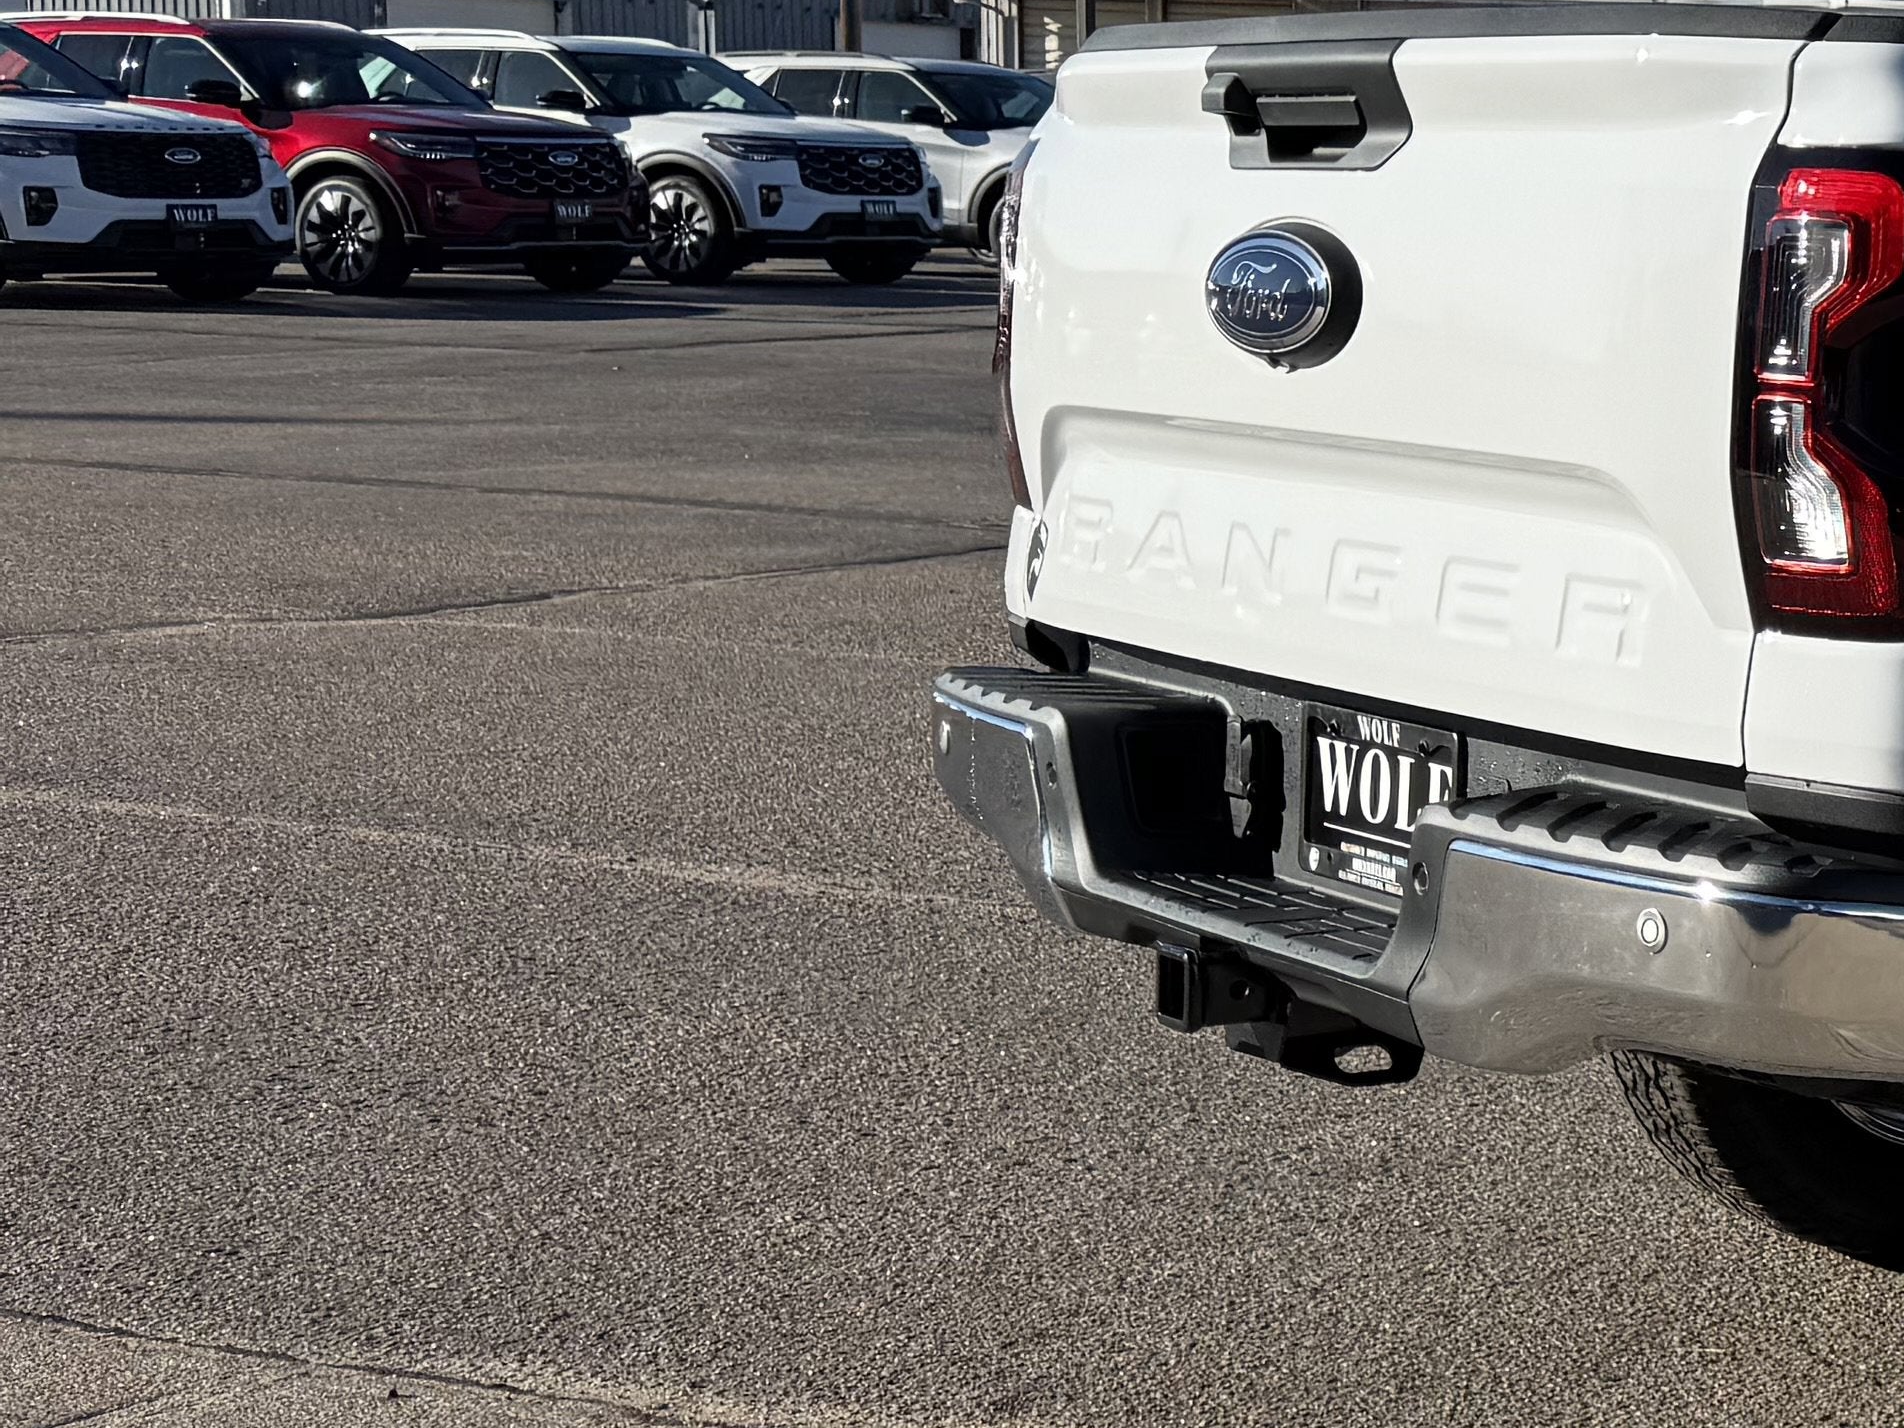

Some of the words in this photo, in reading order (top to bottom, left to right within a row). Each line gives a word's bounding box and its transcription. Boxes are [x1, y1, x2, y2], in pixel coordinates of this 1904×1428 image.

[173, 208, 216, 222] WOLF
[1226, 260, 1291, 322] Ford
[1058, 493, 1652, 668] RANGER
[1357, 715, 1400, 747] WOLF
[1316, 736, 1453, 832] WOLF
